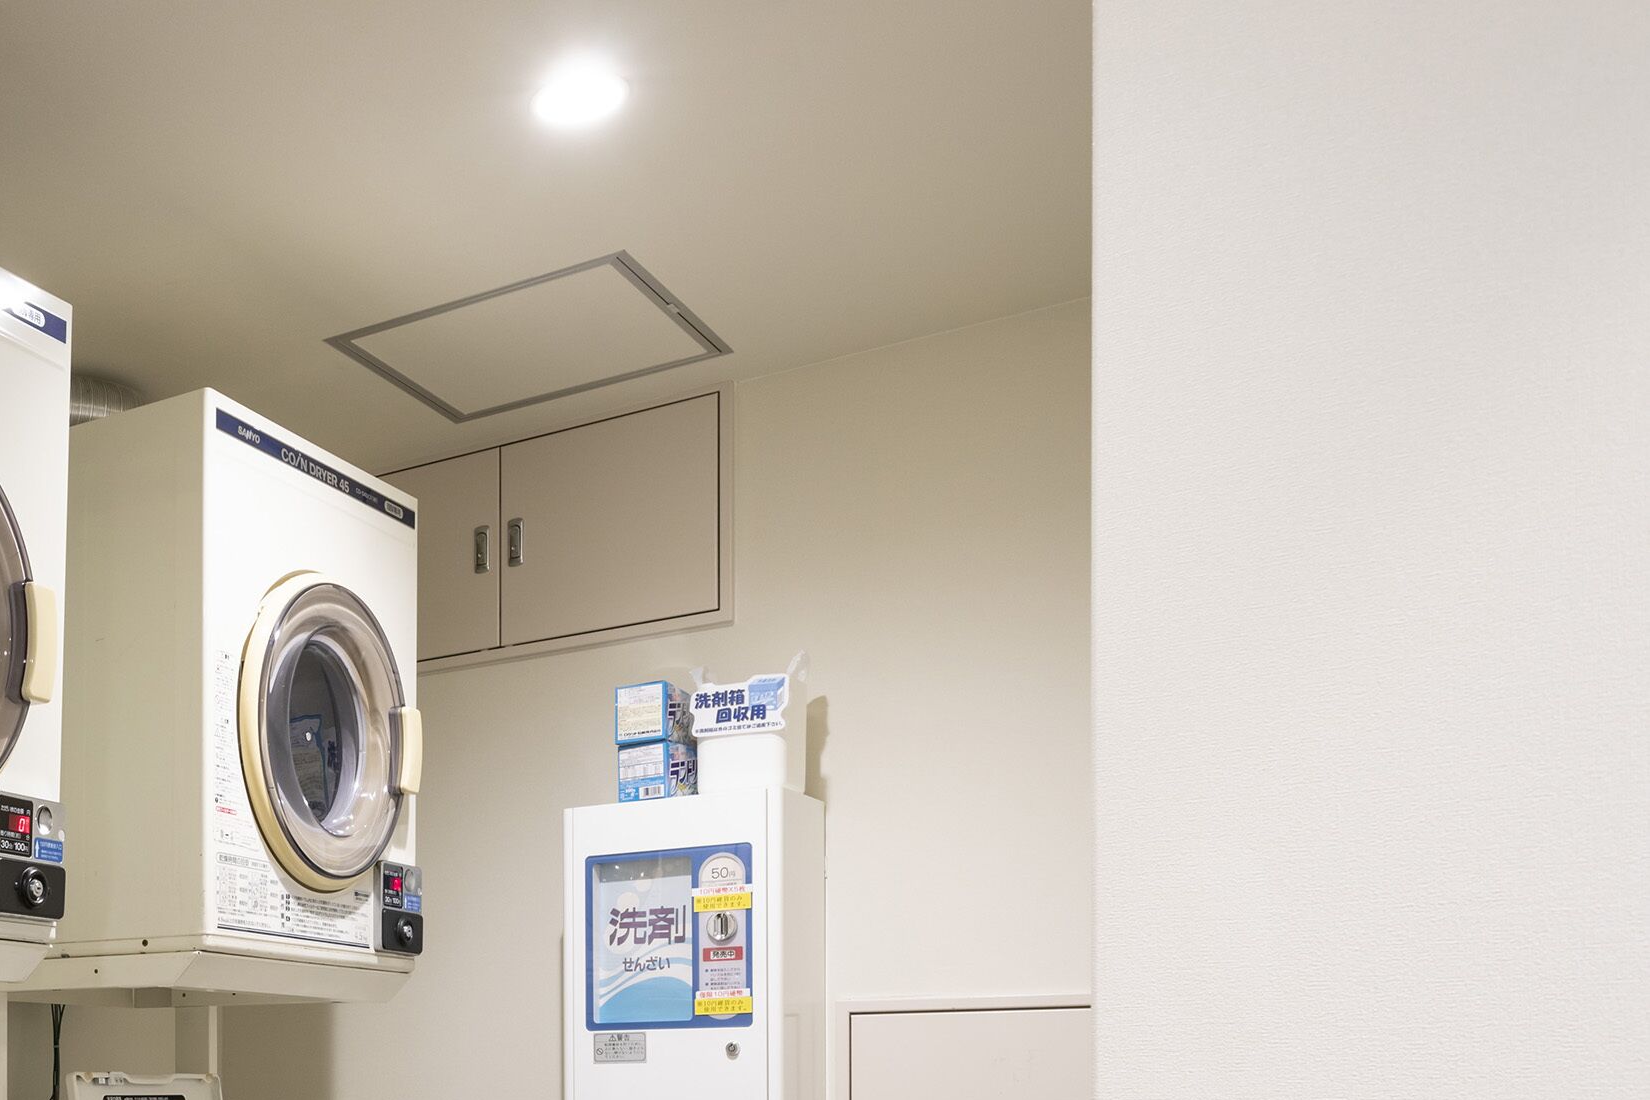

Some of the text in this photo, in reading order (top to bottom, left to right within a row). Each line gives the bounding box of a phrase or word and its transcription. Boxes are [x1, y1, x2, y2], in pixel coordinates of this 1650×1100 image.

[238, 426, 261, 444] SANYO
[309, 461, 338, 487] DRYER
[339, 477, 350, 494] 45
[695, 689, 745, 709] 洗剤箱
[716, 704, 766, 724] 回収用
[609, 904, 687, 947] 洗剤
[622, 956, 671, 973] せんざい
[712, 950, 735, 959] 発売中
